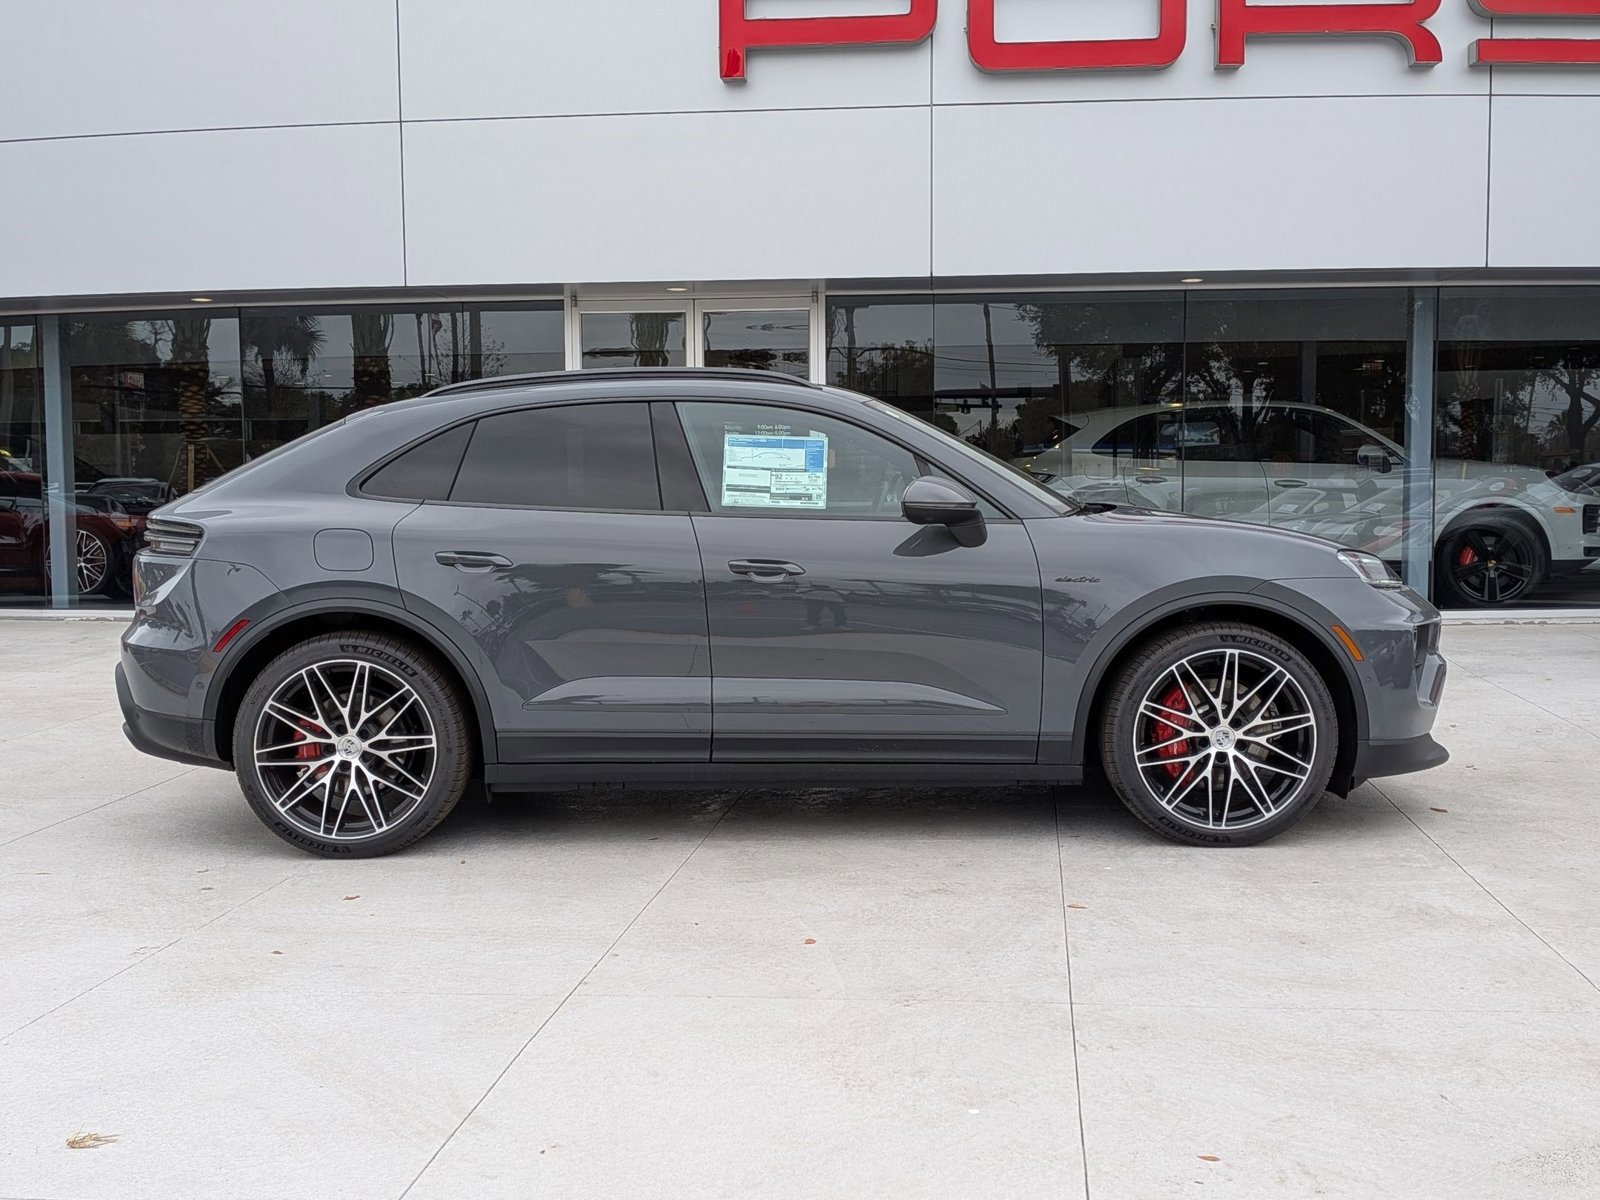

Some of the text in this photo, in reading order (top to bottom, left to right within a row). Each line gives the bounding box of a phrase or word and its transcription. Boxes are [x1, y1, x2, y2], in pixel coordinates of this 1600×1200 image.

[1054, 575, 1101, 583] electric
[357, 645, 416, 676] MICHELIN
[1234, 635, 1291, 661] MICHELIN
